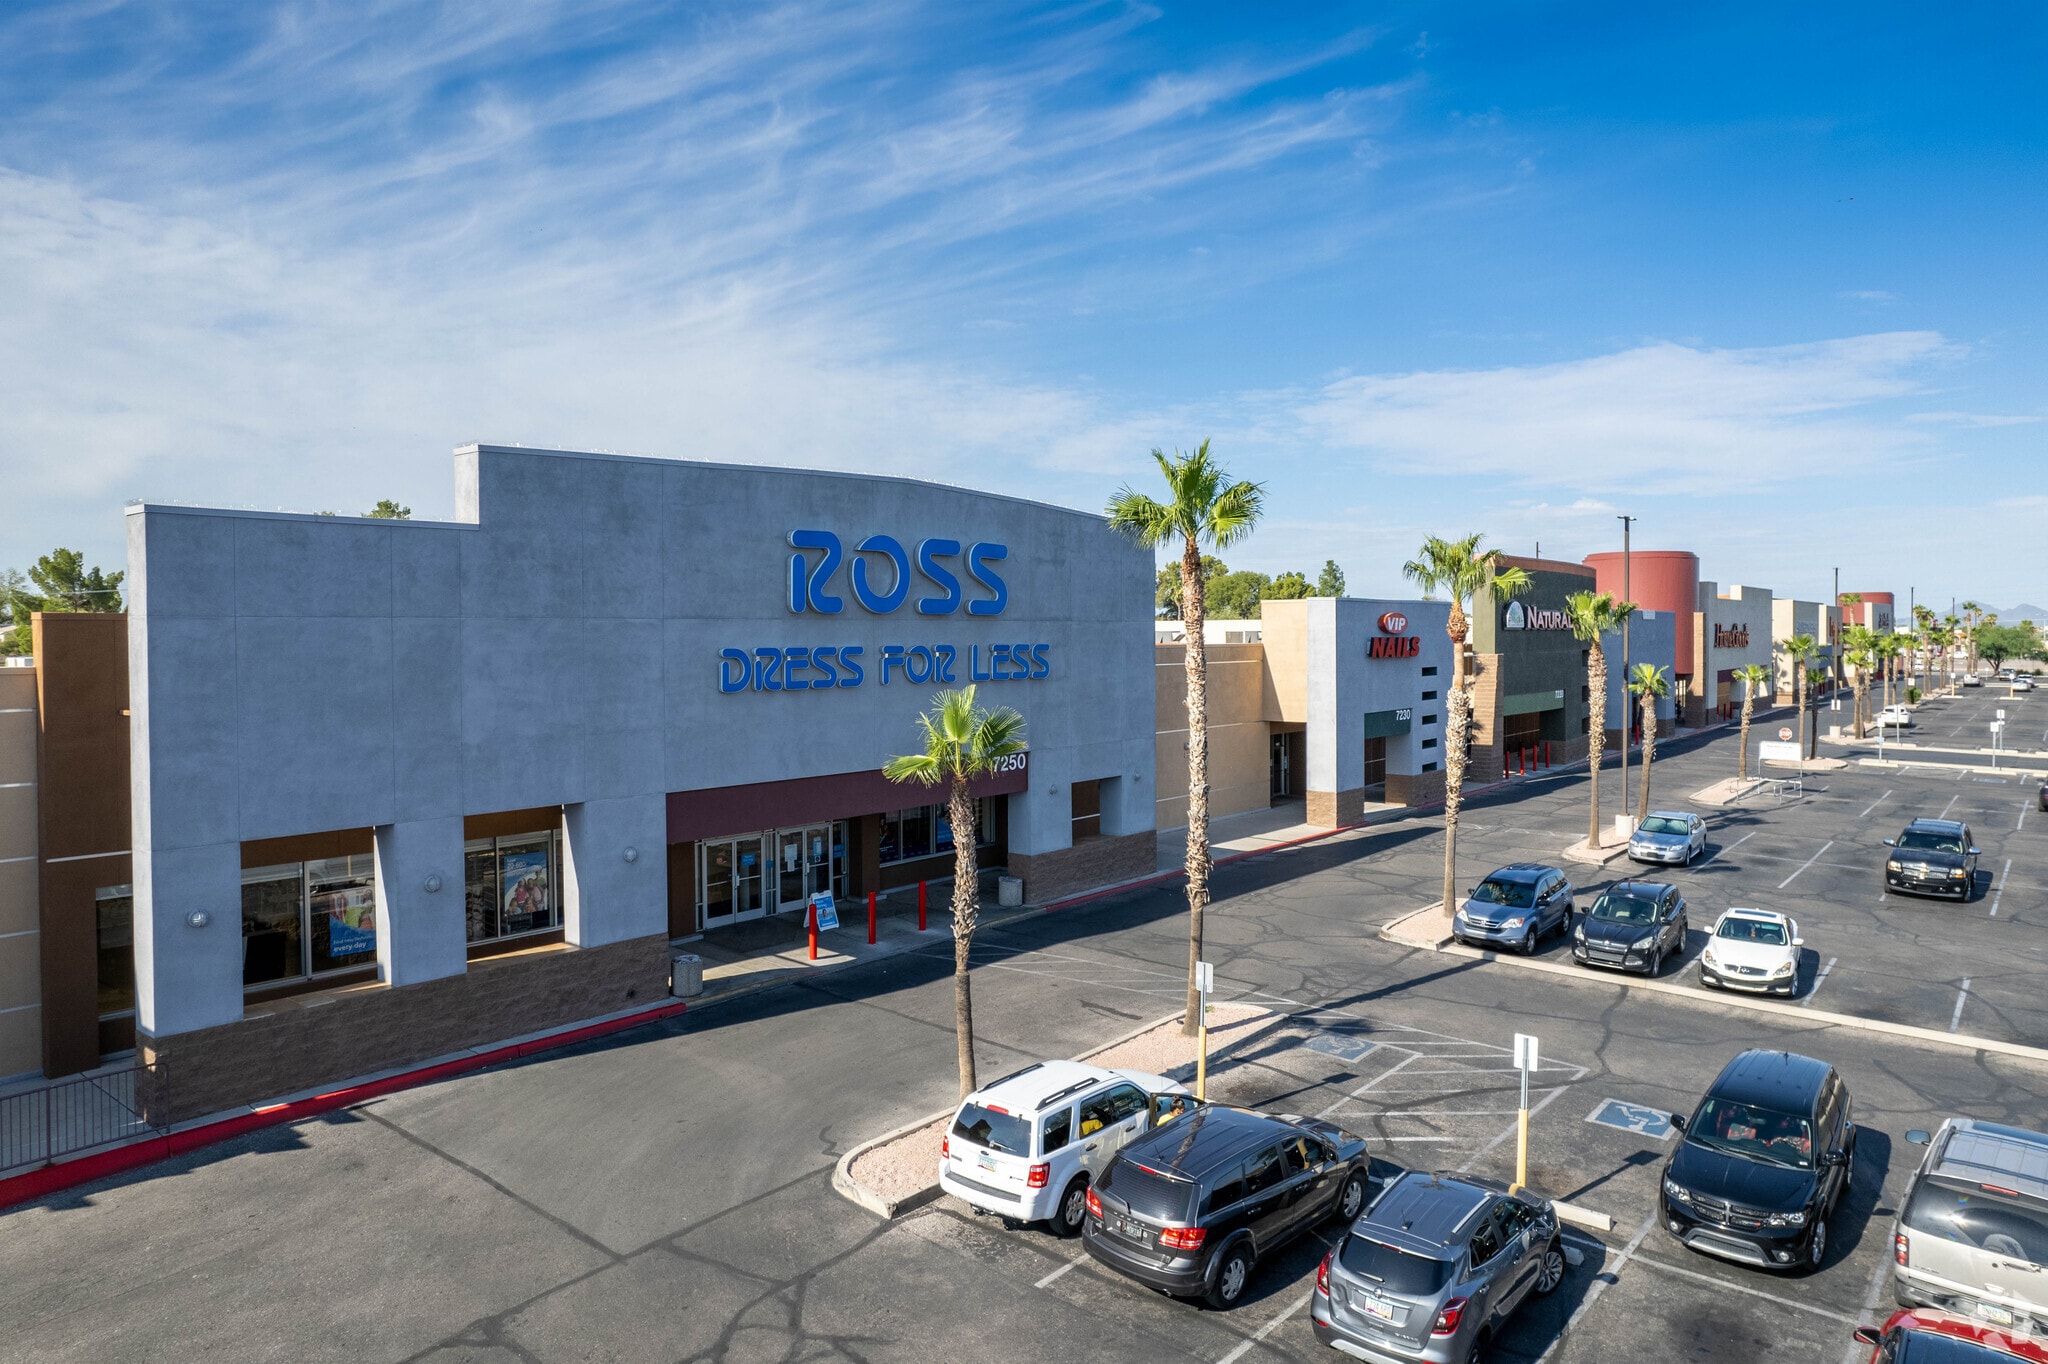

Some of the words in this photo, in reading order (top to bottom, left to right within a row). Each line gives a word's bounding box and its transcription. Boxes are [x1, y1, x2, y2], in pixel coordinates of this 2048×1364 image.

[786, 530, 1008, 616] ROSS
[1387, 617, 1406, 631] VIP
[1371, 636, 1421, 659] NAILS
[718, 646, 865, 693] DRESS
[880, 644, 957, 686] FOR
[970, 644, 1051, 681] LESS
[1396, 709, 1411, 721] 7230
[993, 753, 1026, 773] 7250
[333, 944, 353, 952] every
[353, 941, 367, 950] day
